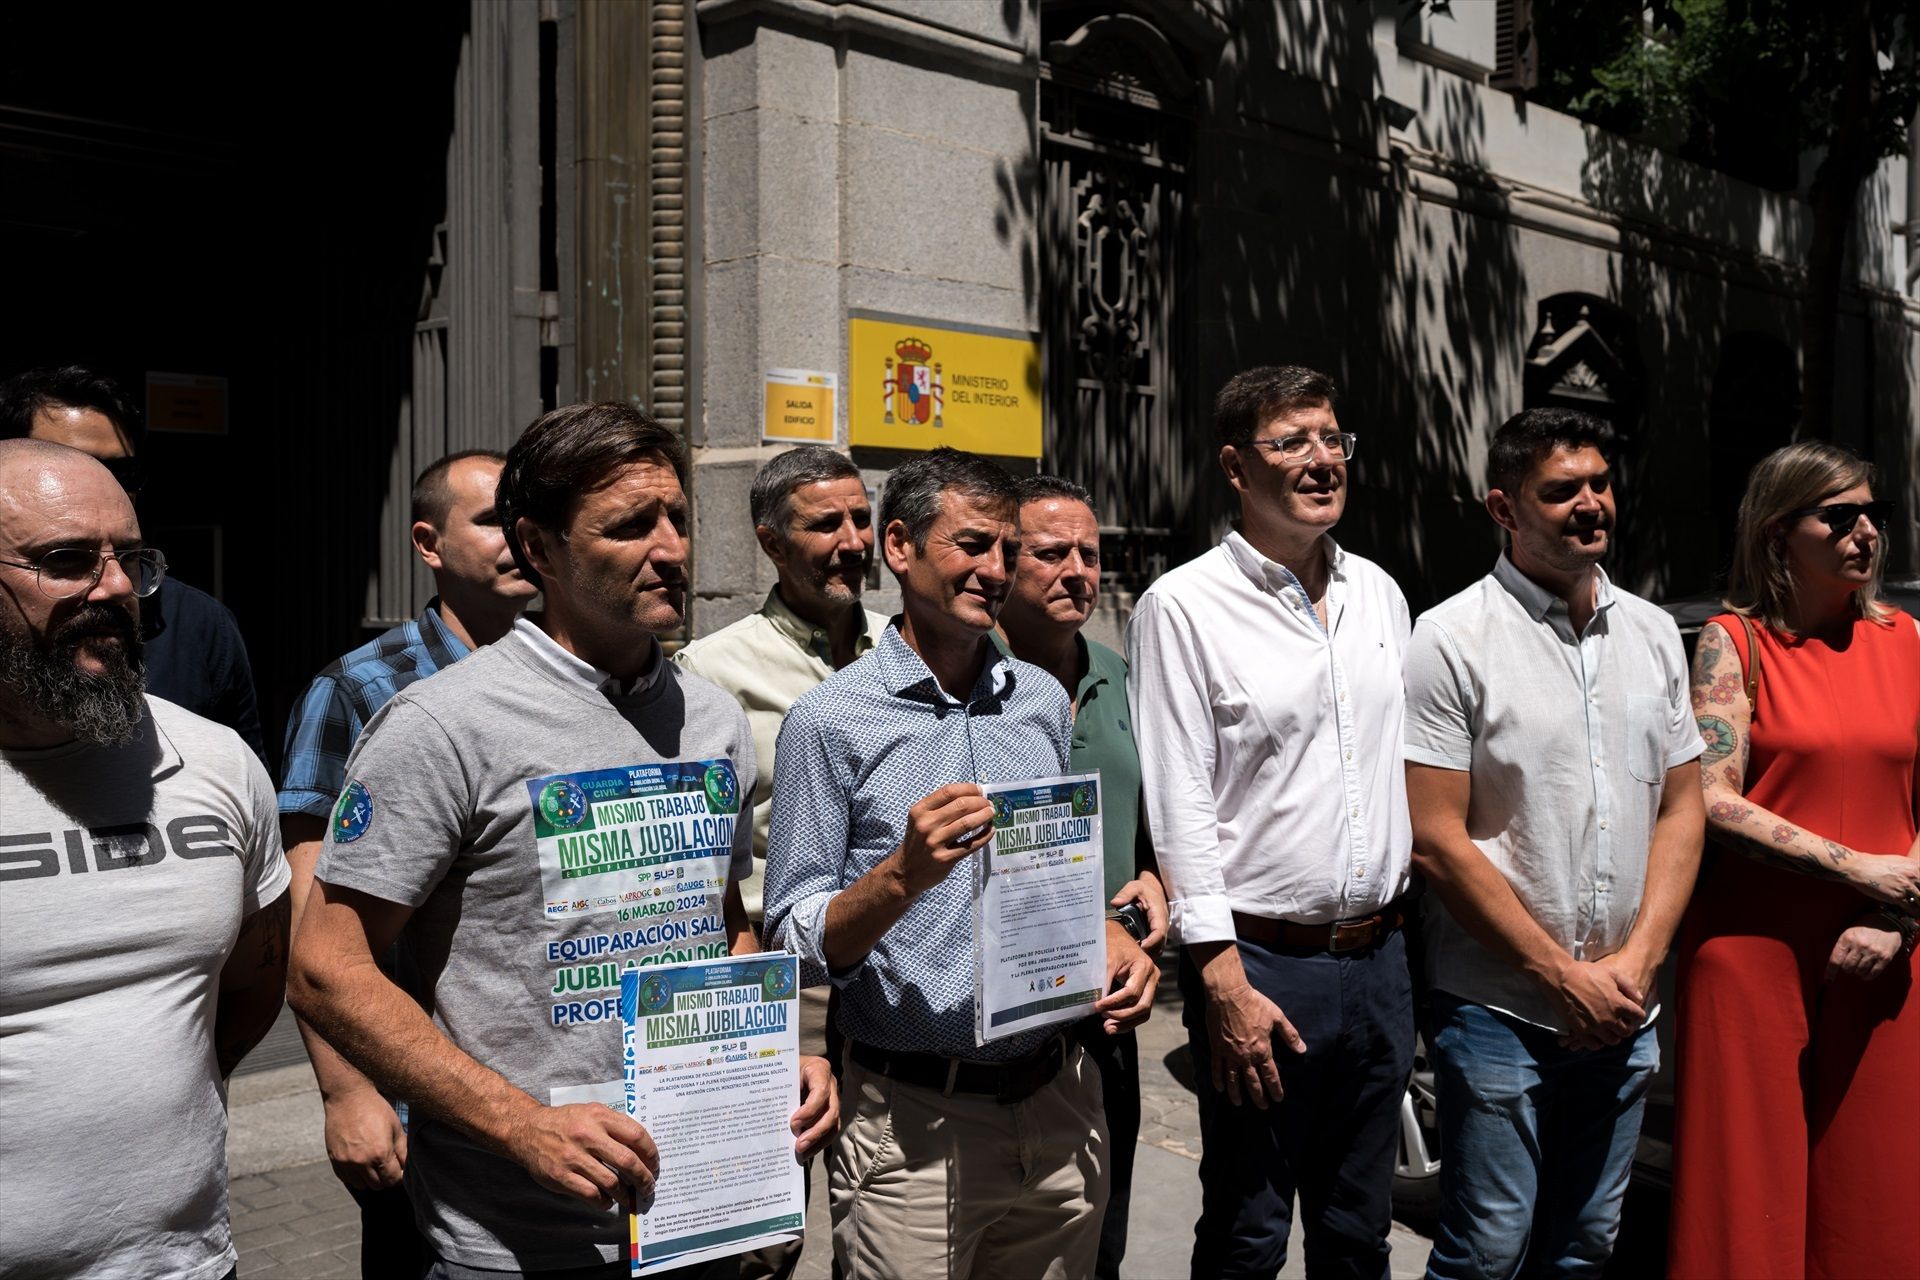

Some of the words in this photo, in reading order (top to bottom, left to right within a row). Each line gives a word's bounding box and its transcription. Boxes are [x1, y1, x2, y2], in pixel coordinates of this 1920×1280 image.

[951, 374, 1008, 391] MINISTERIO
[786, 400, 812, 409] SALIDA
[952, 390, 970, 404] DEL
[974, 393, 1019, 408] INTERIOR
[784, 415, 816, 425] EDIFICIO
[582, 779, 624, 790] GUARDIA
[593, 789, 619, 798] CIVIL
[596, 801, 646, 826] MISMO
[647, 794, 706, 819] TRABAJO
[1016, 806, 1040, 824] MISMO
[1042, 804, 1071, 822] TRABAJO
[557, 829, 635, 870] MISMA
[639, 814, 734, 857] JUBILACIÓN
[996, 826, 1032, 850] MISMA
[1034, 816, 1091, 844] JUBILACIÓN
[618, 908, 630, 922] 16
[632, 901, 675, 920] MARZO
[677, 894, 707, 912] 2024
[549, 919, 686, 960] EQUIPARACIÓN
[676, 992, 712, 1012] MISMO
[715, 987, 759, 1006] TRABAJO
[646, 1013, 701, 1042] MISMA
[705, 1000, 788, 1035] JUBILACIÓN
